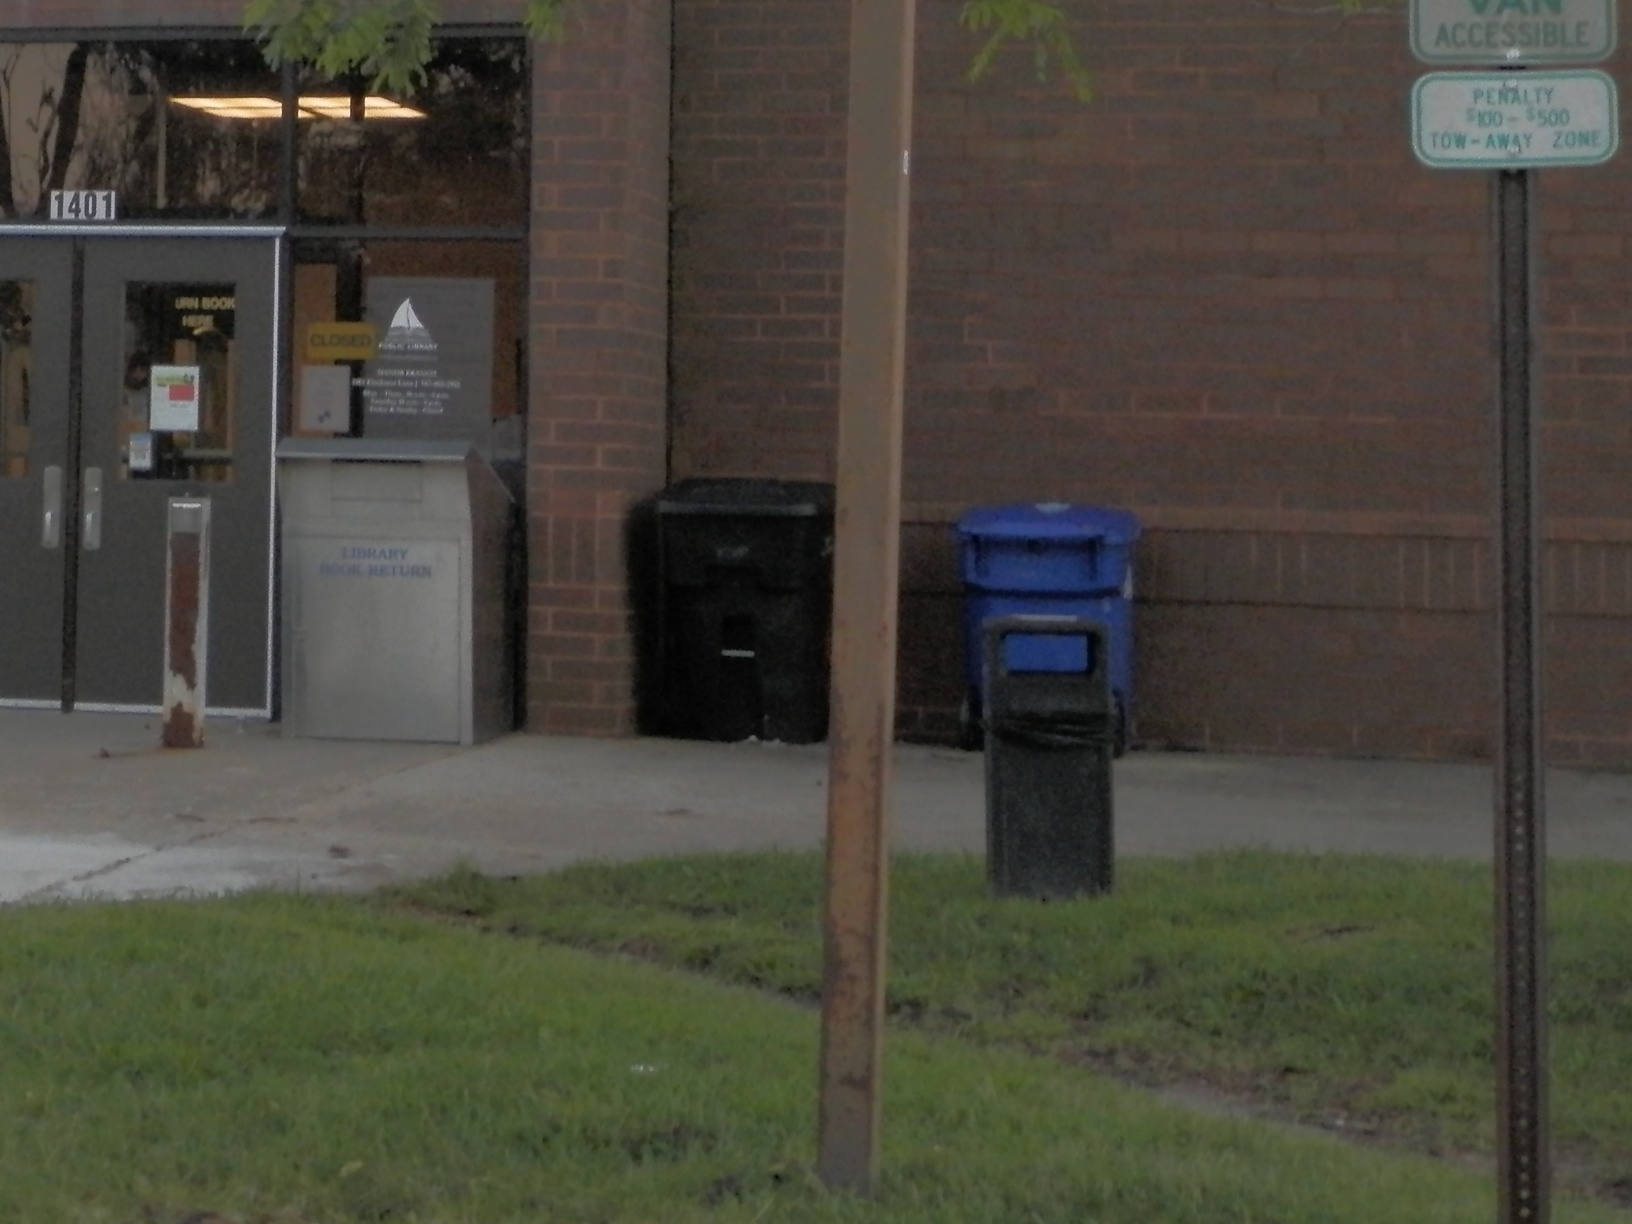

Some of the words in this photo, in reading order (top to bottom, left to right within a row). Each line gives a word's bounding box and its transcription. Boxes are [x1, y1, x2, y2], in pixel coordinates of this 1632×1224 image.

[1434, 21, 1590, 48] ACCESSIBLE
[1472, 87, 1555, 105] PENALTY
[1552, 130, 1602, 149] ZONE
[54, 190, 112, 220] 1401
[310, 333, 371, 347] CLOSED
[343, 546, 408, 560] LIBRARY
